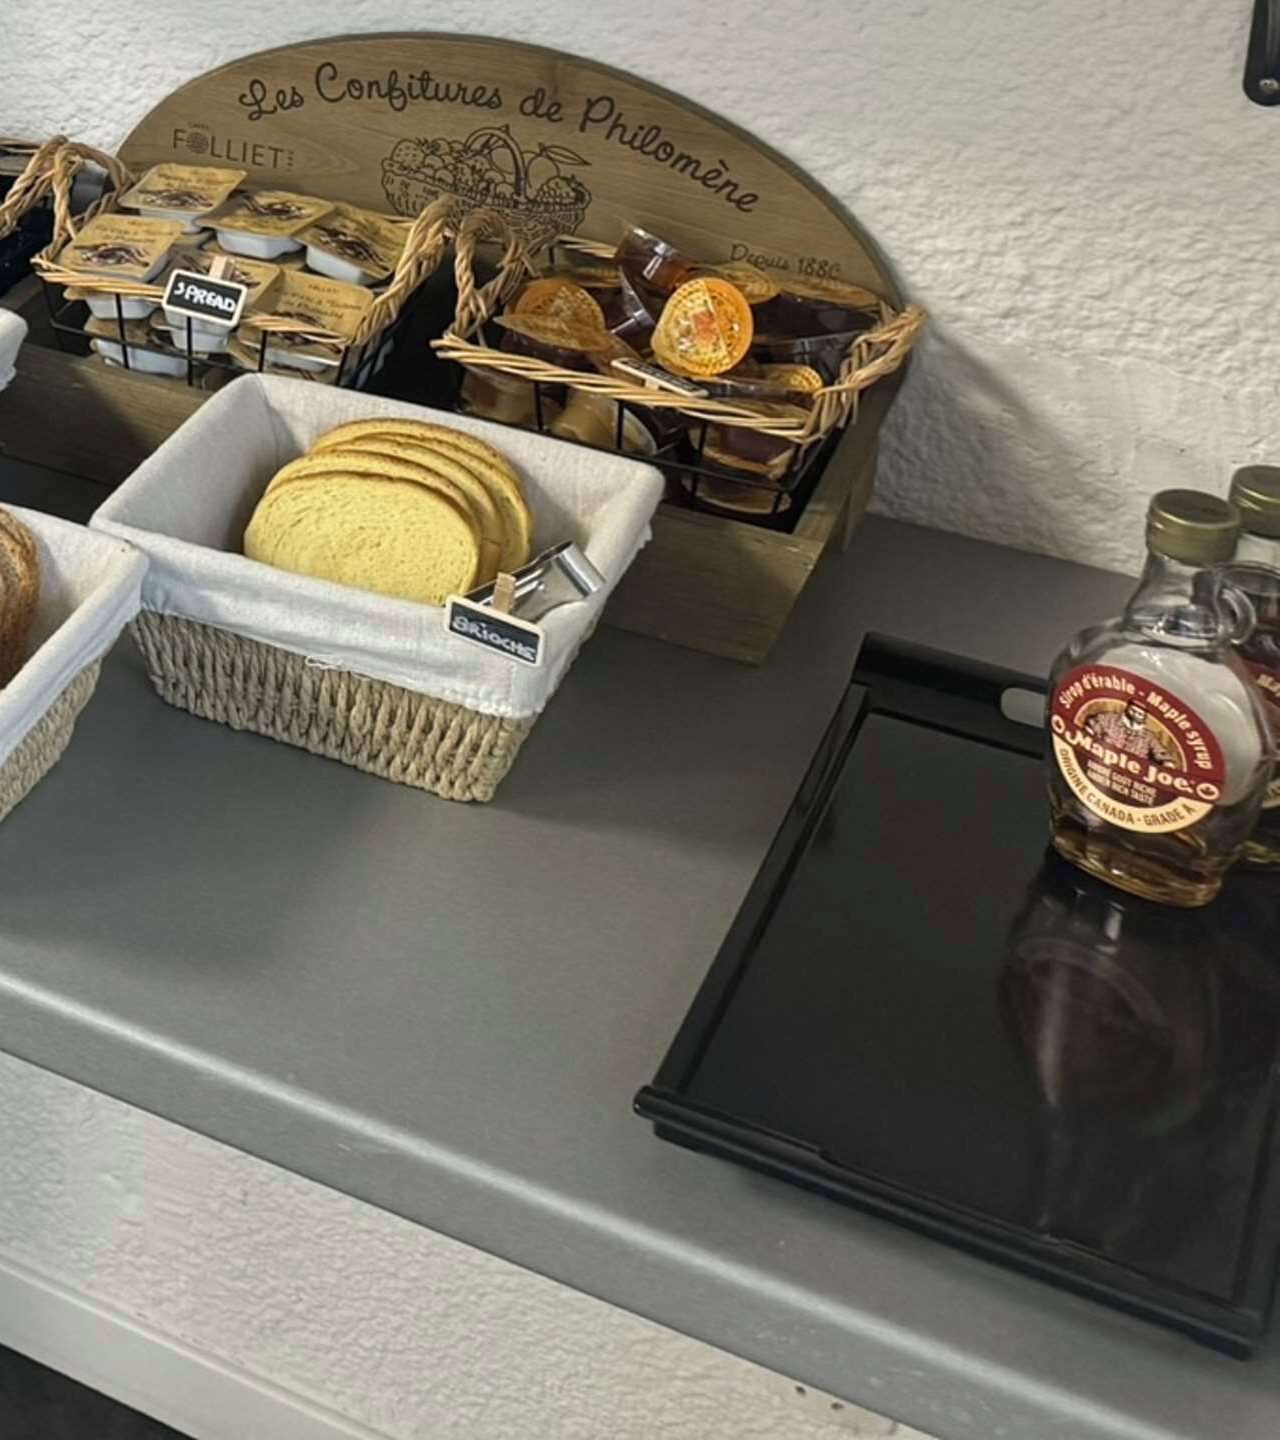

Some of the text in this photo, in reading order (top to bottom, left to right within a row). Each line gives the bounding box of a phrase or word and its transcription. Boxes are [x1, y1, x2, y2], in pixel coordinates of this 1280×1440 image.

[238, 62, 760, 213] Les Confitures de Philomène
[730, 243, 790, 273] Depuis
[173, 281, 236, 313] SPREAD
[1065, 727, 1193, 794] Maple Joe
[1146, 691, 1190, 730] Maple
[1185, 726, 1213, 770] syrup
[1059, 748, 1197, 826] ORIGINE CANADA GRADE A
